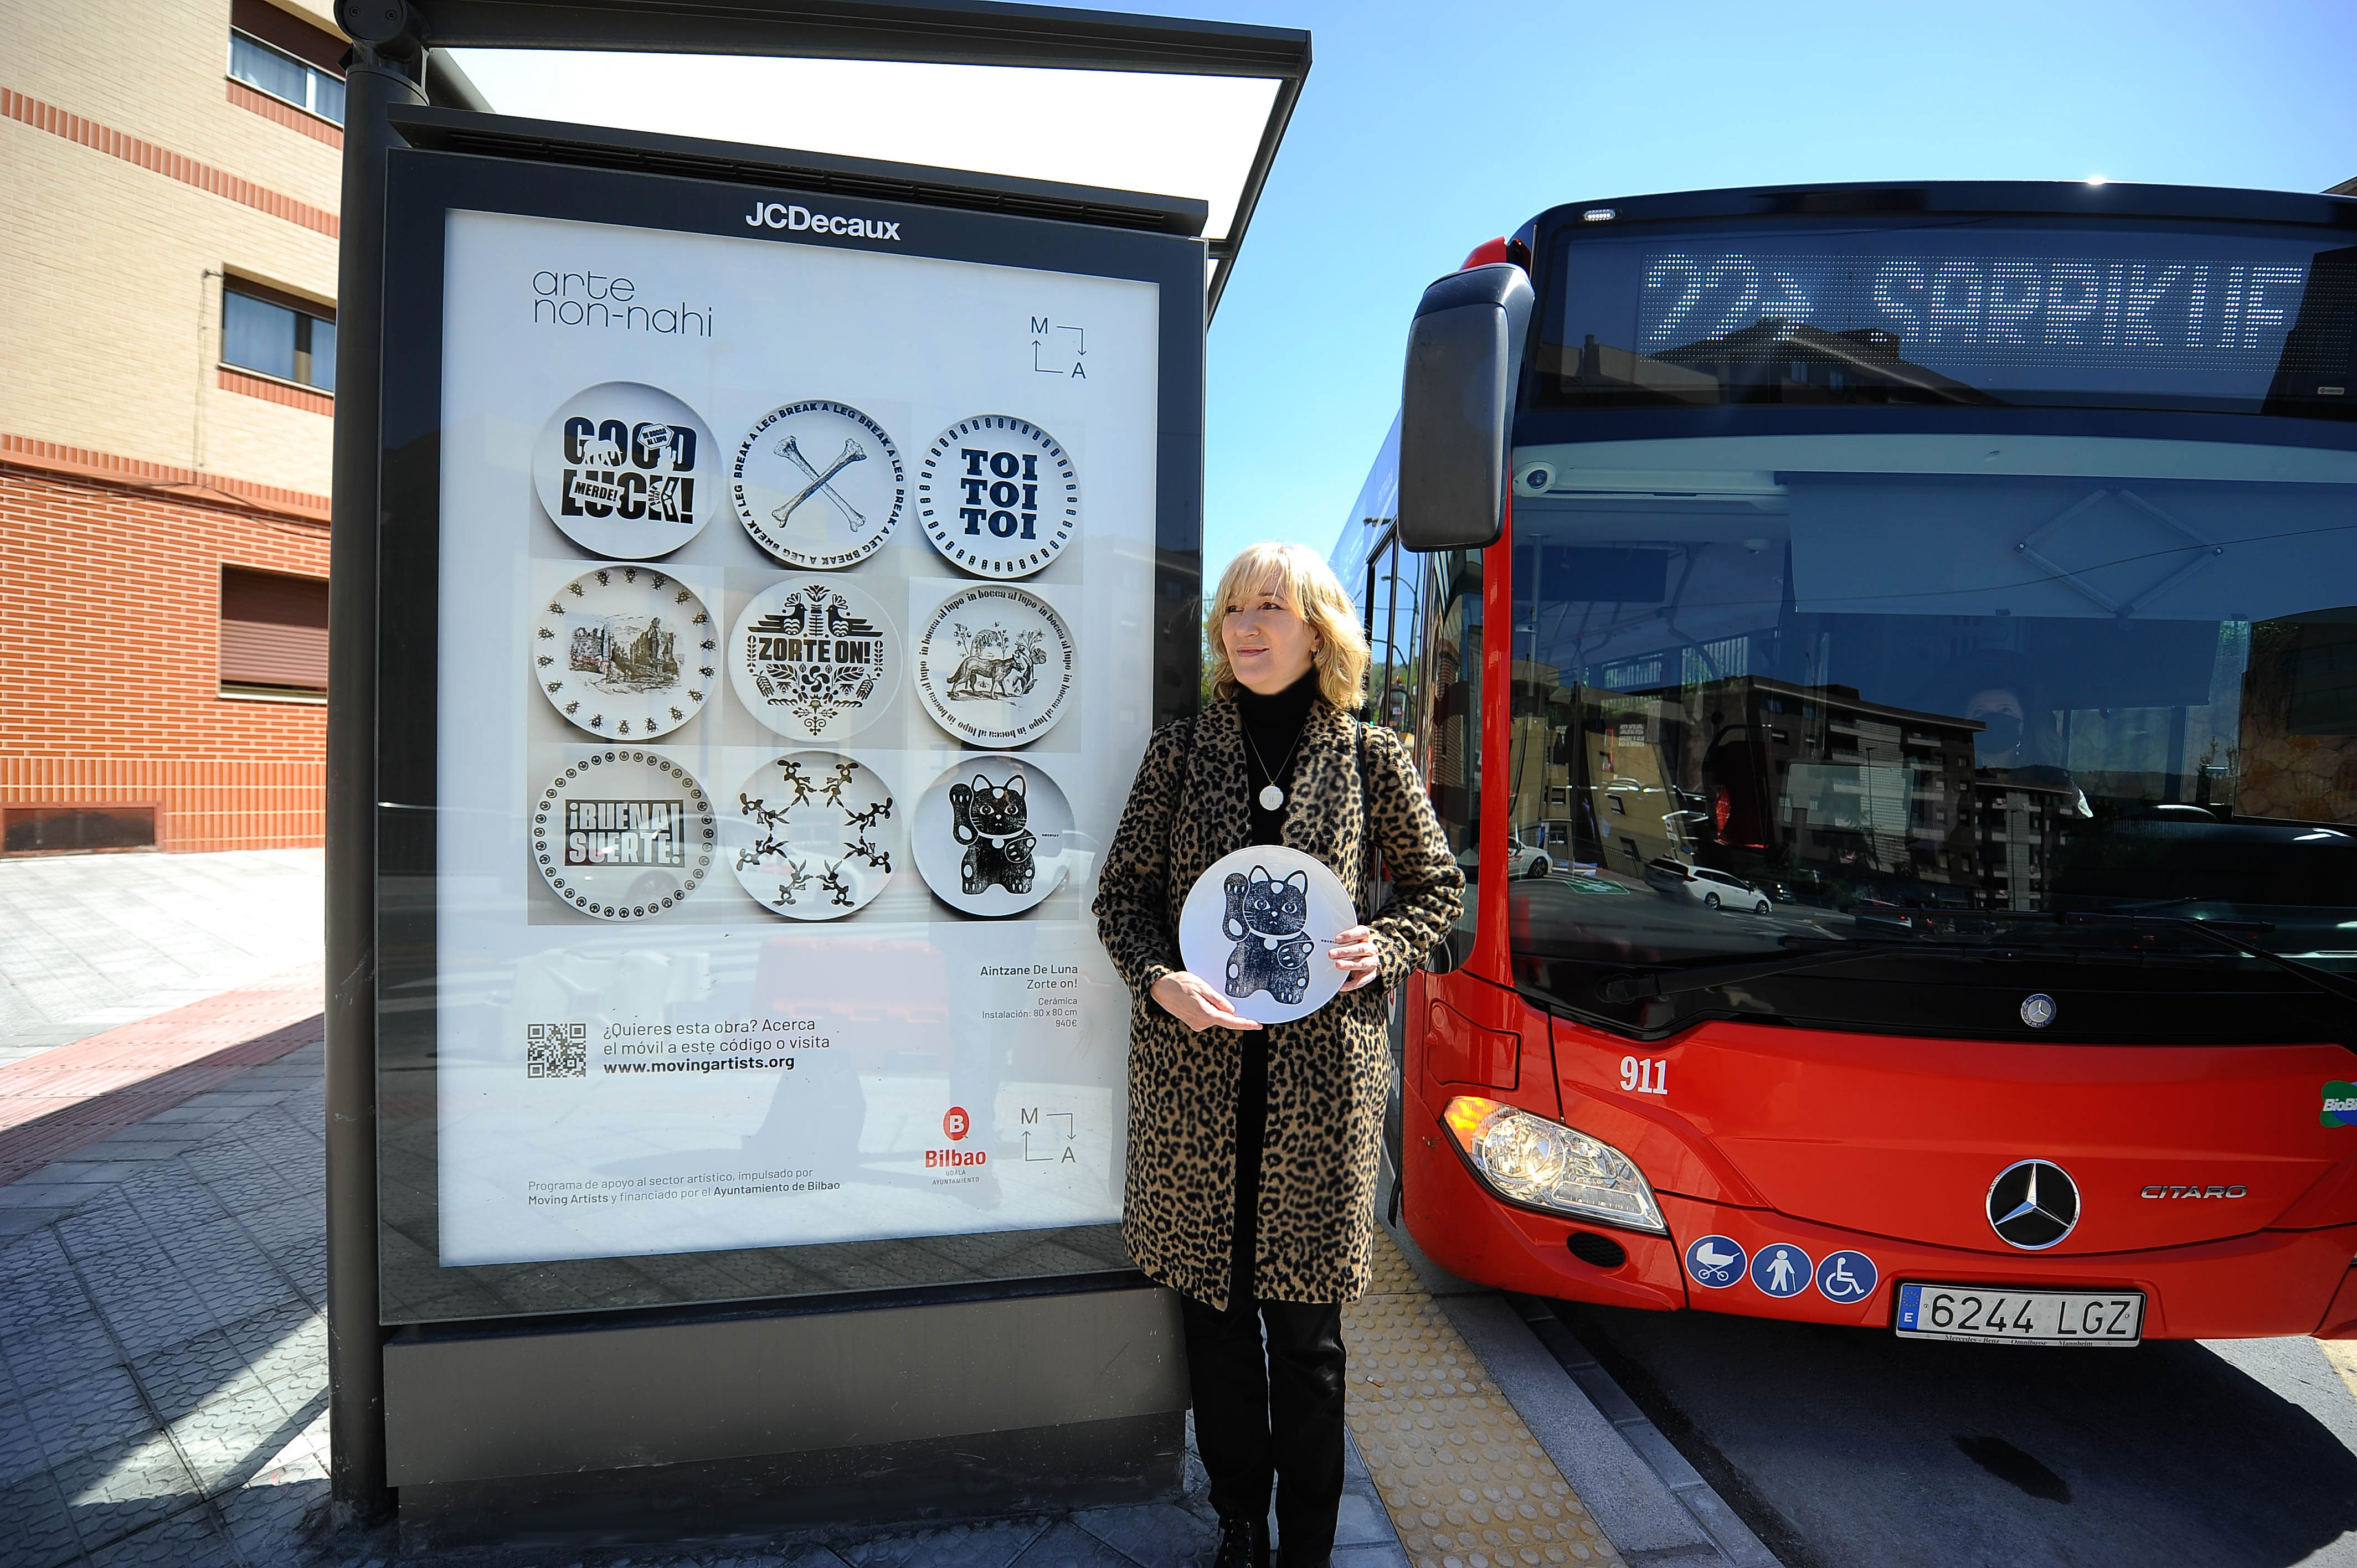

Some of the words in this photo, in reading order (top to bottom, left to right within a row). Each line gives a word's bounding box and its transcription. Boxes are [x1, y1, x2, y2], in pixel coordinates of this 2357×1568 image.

[745, 202, 901, 241] JCDecaux
[533, 271, 635, 302] arte
[534, 299, 712, 337] non-nahi
[1031, 316, 1048, 334] M
[1071, 362, 1086, 379] A
[779, 403, 817, 418] BREAK
[833, 405, 855, 419] LEG
[564, 416, 697, 472] GOOD
[734, 441, 752, 478] BREAK
[756, 415, 778, 432] LEG
[858, 416, 891, 447] BREAK
[887, 449, 895, 457] A
[891, 460, 904, 482] LEG
[961, 448, 1037, 481] TOI
[574, 481, 618, 502] MERDE!
[734, 484, 747, 508] LEG
[960, 478, 1038, 510] TOI
[887, 489, 904, 526] BREAK
[881, 527, 890, 535] A
[960, 507, 1037, 540] TOI
[748, 520, 780, 550] BREAK
[863, 535, 883, 553] LEG
[783, 549, 804, 563] LEG
[821, 550, 861, 565] BREAK
[944, 597, 964, 612] lupo
[966, 593, 977, 601] in
[977, 590, 1006, 599] bocca
[1018, 595, 1037, 608] lupo
[922, 619, 940, 644] bocca
[1038, 606, 1048, 617] in
[1047, 614, 1066, 638] bocca
[1063, 651, 1072, 670] lupo
[759, 637, 831, 663] ZORTE
[835, 641, 871, 664] ON!
[919, 647, 928, 655] in
[1063, 675, 1072, 684] in
[1051, 684, 1070, 709] bocca
[1029, 715, 1047, 730] lupo
[980, 966, 1030, 976] Aintzane
[1033, 965, 1048, 974] De
[1051, 964, 1078, 974] Luna
[1027, 979, 1057, 989] Zorte
[1060, 979, 1077, 988] on!
[1038, 997, 1077, 1005] Cerámica
[982, 1010, 1031, 1019] Instalación:
[1033, 1009, 1044, 1017] 80
[604, 1023, 671, 1039] ¿Quieres
[676, 1023, 709, 1034] esta
[714, 1019, 758, 1033] obra?
[762, 1019, 815, 1031] Acerca
[604, 1042, 616, 1055] el
[622, 1041, 663, 1054] móvil
[668, 1043, 676, 1053] a
[682, 1041, 714, 1053] este
[720, 1038, 771, 1053] código
[776, 1039, 785, 1049] o
[790, 1036, 830, 1049] visita
[604, 1056, 794, 1074] www.movingartists.org
[1620, 1056, 1668, 1095] 911
[1021, 1107, 1038, 1125] M
[925, 1149, 986, 1168] Bilbao
[1061, 1147, 1076, 1163] A
[528, 1181, 581, 1192] Programa
[585, 1180, 598, 1189] de
[601, 1179, 634, 1190] apoyo
[637, 1177, 646, 1187] al
[649, 1176, 685, 1185] sector
[687, 1173, 735, 1184] artístico,
[738, 1169, 793, 1182] impulsado
[796, 1169, 814, 1178] por
[932, 1177, 979, 1185] AYUNTAMIENTO
[528, 1195, 567, 1206] Moving
[570, 1194, 608, 1204] Artists
[611, 1195, 617, 1204] y
[620, 1190, 677, 1201] financiado
[681, 1190, 699, 1200] por
[702, 1188, 711, 1196] el
[713, 1183, 789, 1198] Ayuntamiento
[792, 1182, 805, 1191] de
[807, 1181, 840, 1190] Bilbao
[2140, 1185, 2248, 1199] CITARO
[1903, 1312, 1913, 1322] E
[1931, 1293, 2034, 1334] 6244
[2057, 1301, 2130, 1335] LGZ
[1945, 1334, 1977, 1343] Mercedes
